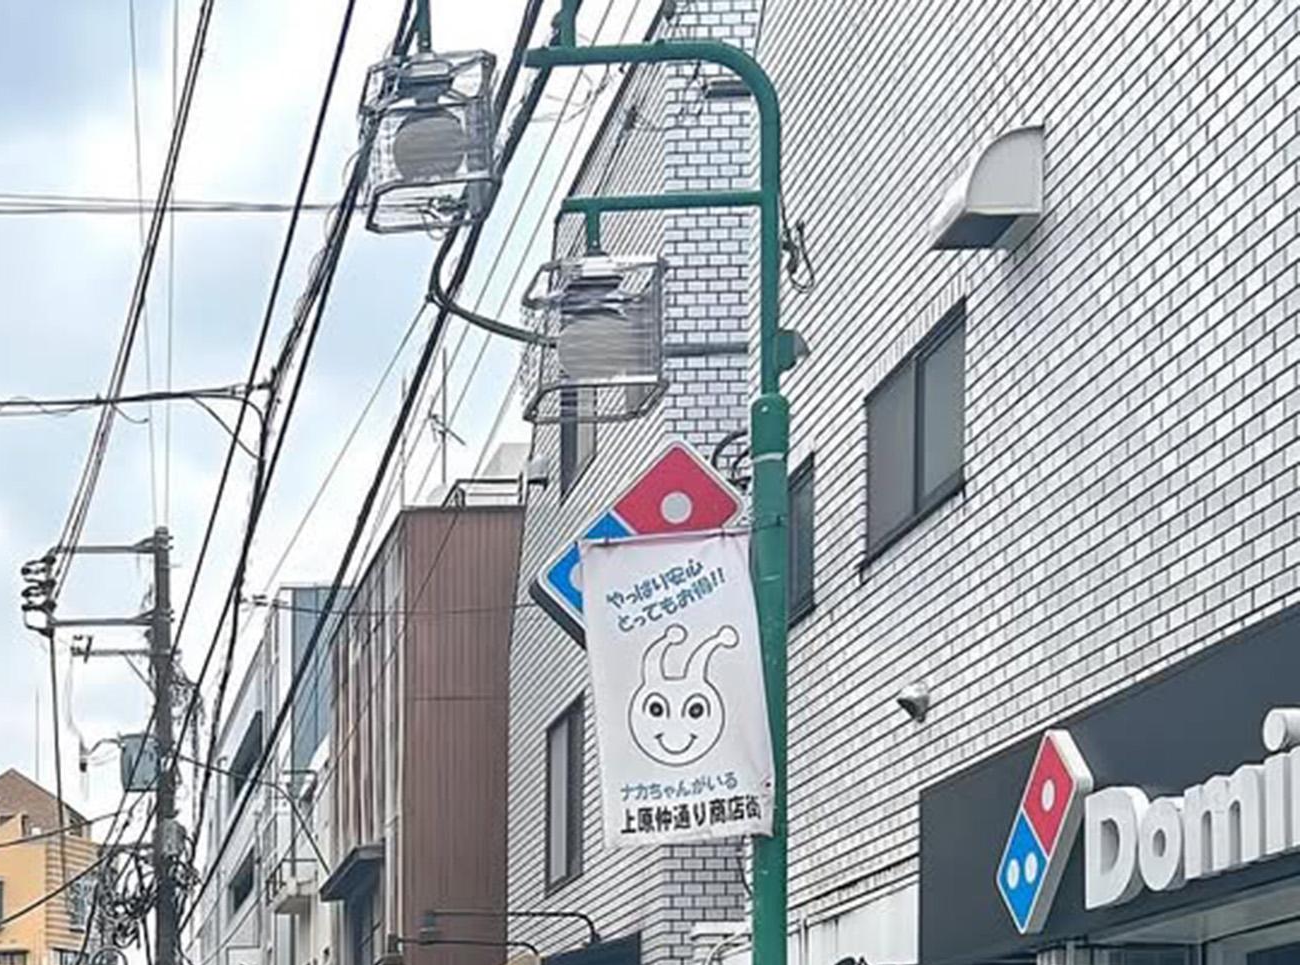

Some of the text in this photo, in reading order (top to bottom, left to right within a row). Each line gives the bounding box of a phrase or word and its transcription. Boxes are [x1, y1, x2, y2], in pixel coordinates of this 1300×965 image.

[620, 771, 738, 801] ナカちゃんがいる
[1084, 707, 1300, 911] Domi
